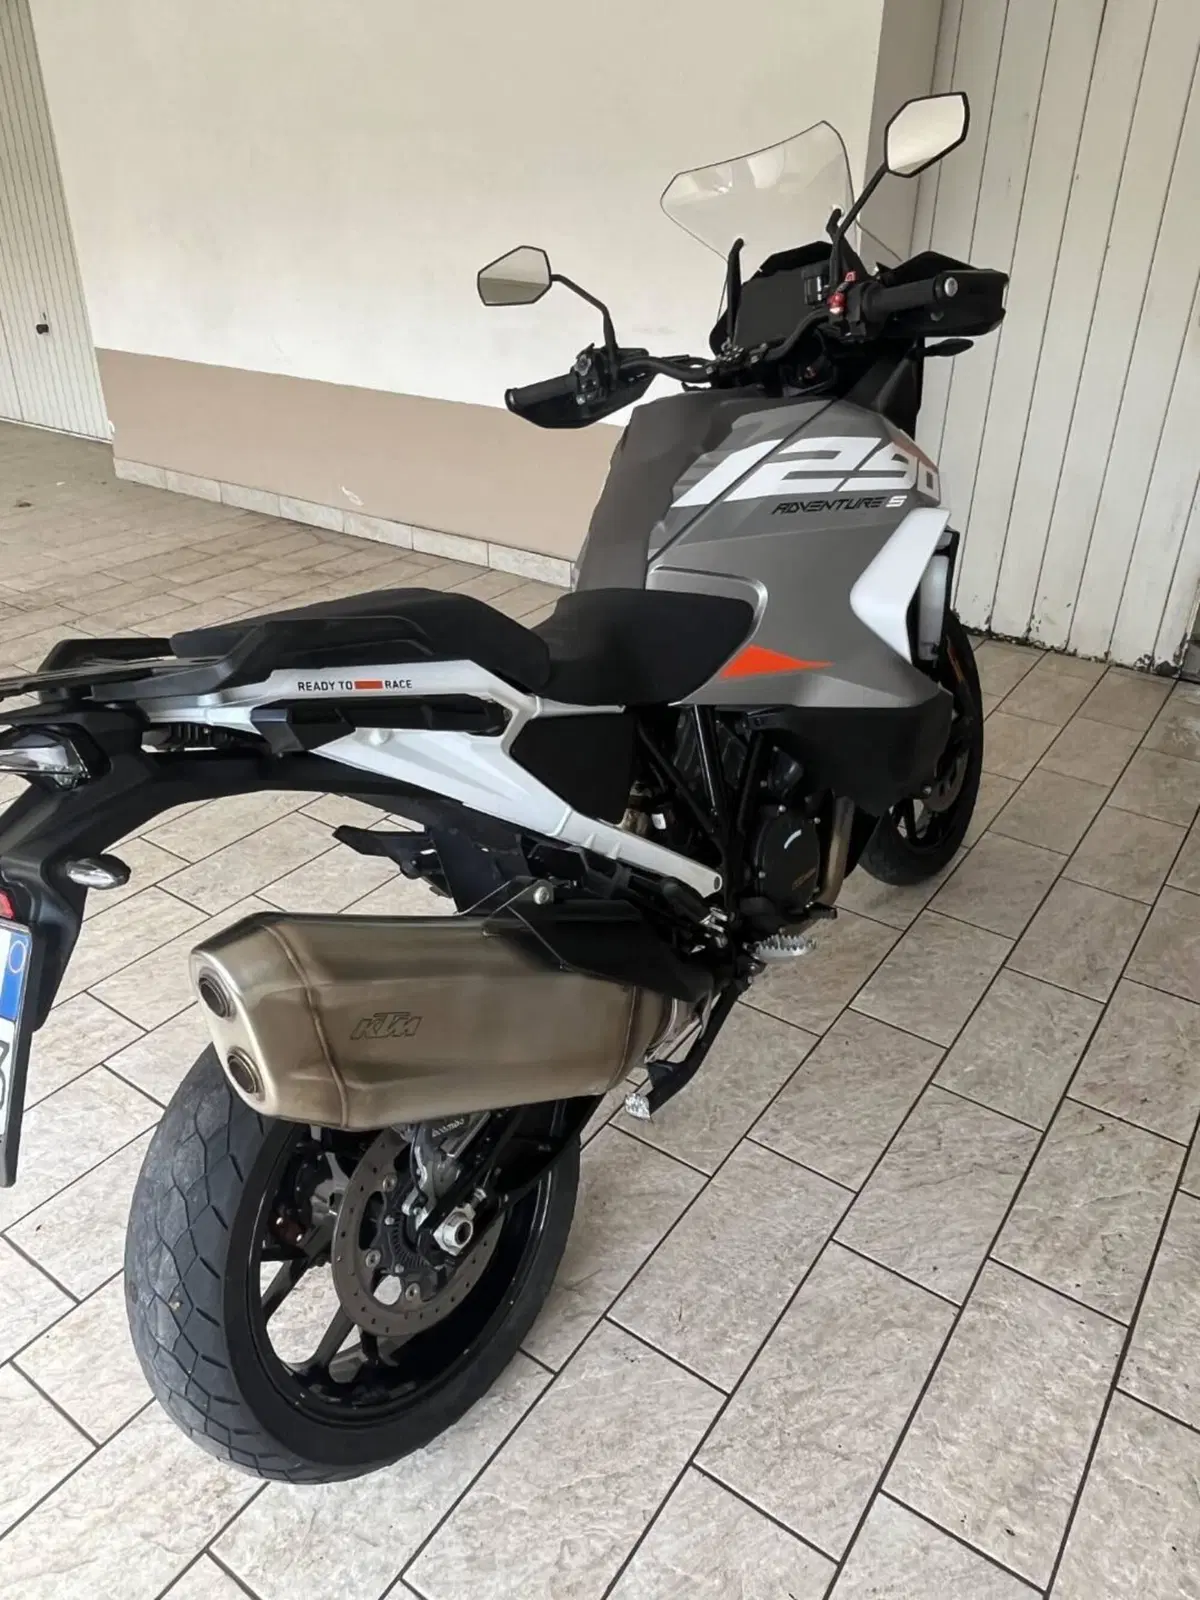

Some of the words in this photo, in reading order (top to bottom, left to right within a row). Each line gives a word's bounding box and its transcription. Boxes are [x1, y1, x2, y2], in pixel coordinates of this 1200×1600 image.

[771, 496, 887, 515] ADVENTURE
[885, 495, 908, 508] S
[297, 681, 335, 692] READY
[338, 680, 353, 691] TO
[384, 679, 412, 689] RACE
[349, 1011, 423, 1040] KTM
